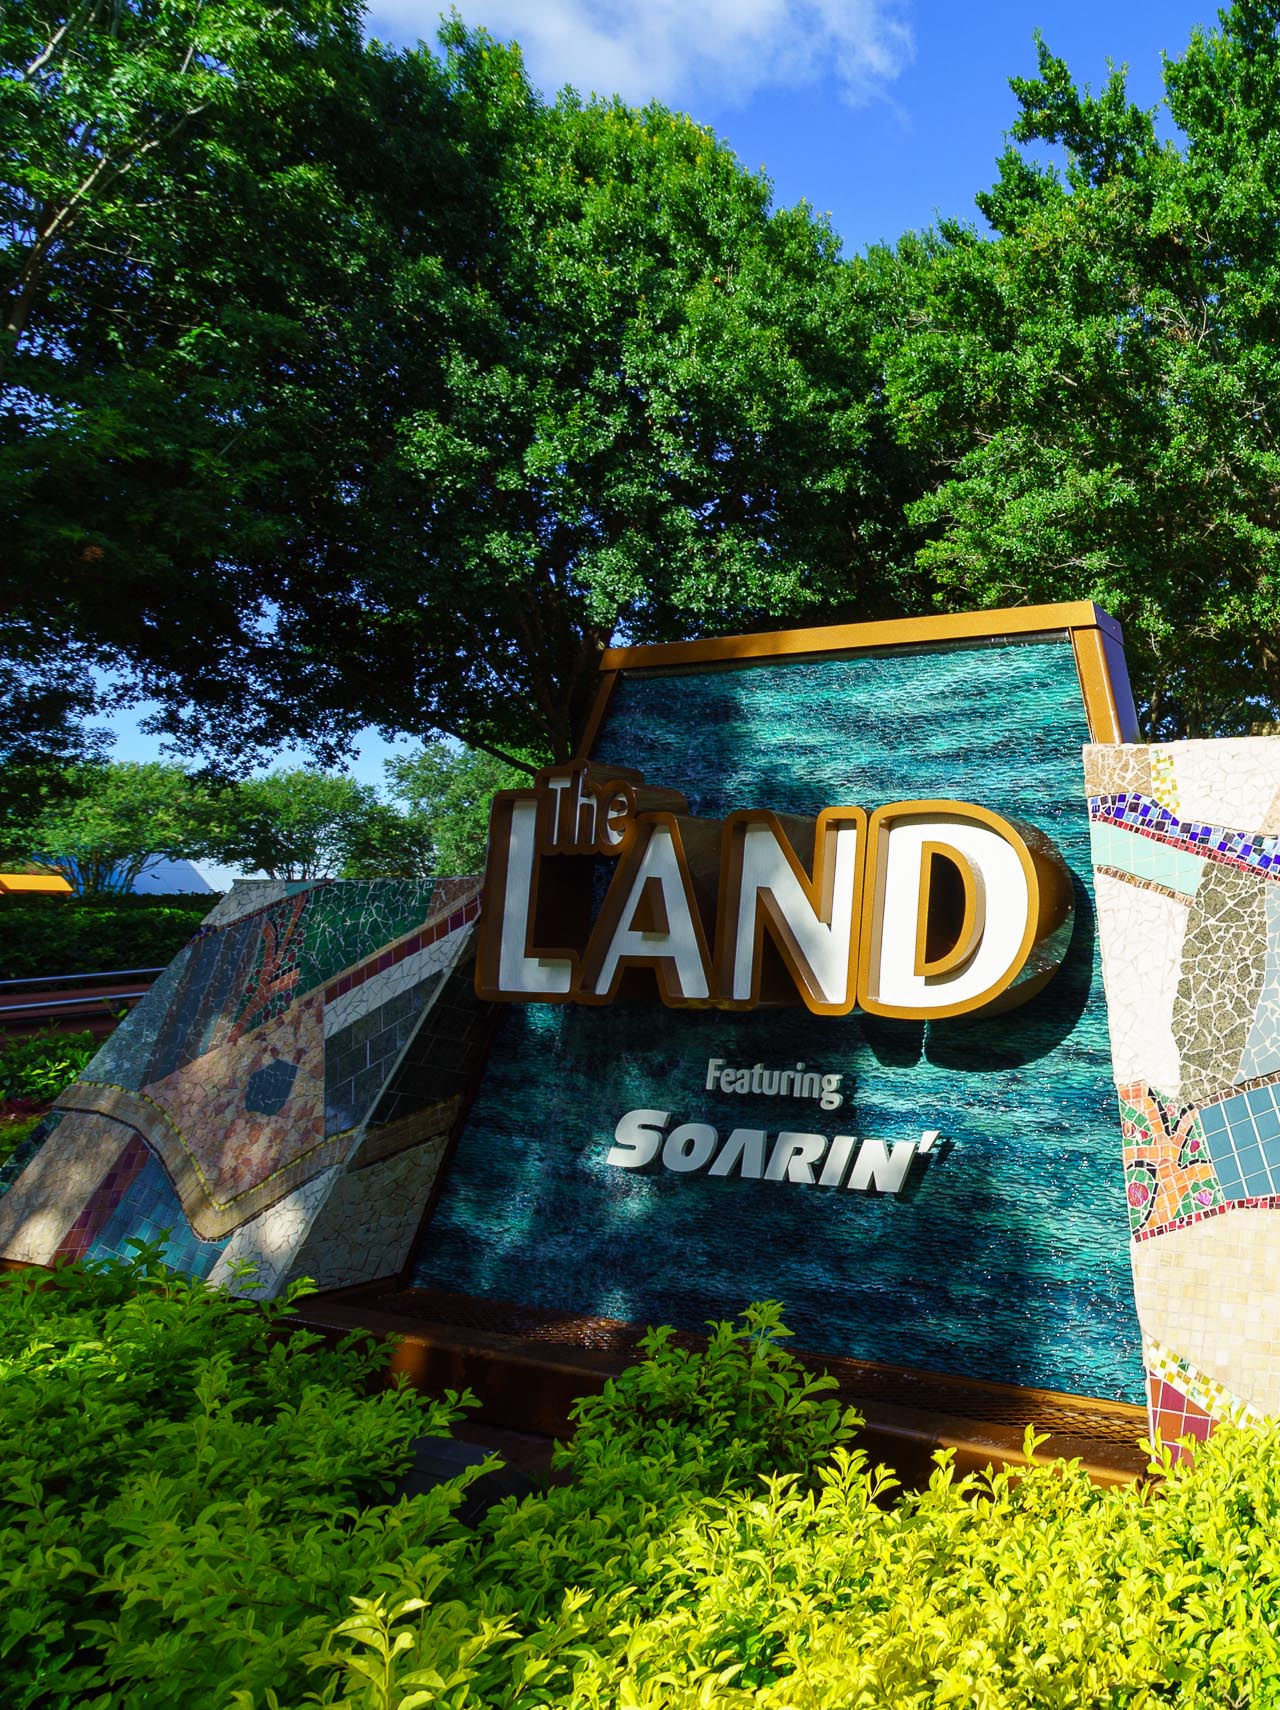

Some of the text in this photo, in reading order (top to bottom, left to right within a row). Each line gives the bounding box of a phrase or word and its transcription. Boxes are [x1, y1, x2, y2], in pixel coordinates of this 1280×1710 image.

[544, 768, 637, 847] The
[494, 796, 1032, 1012] LAND
[705, 1058, 844, 1110] Featuring
